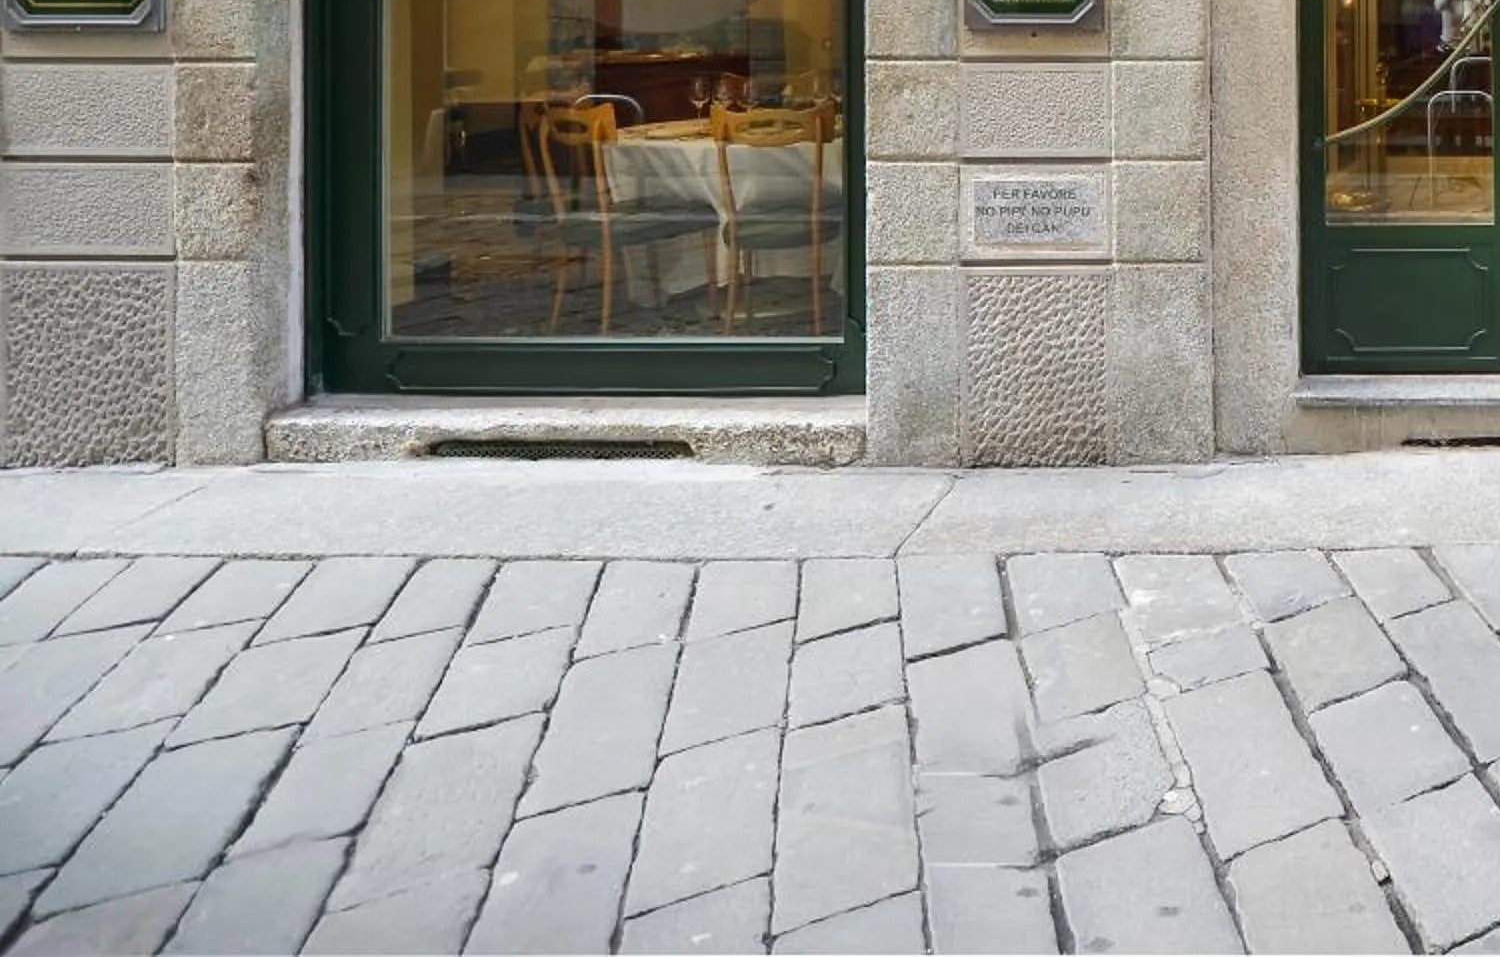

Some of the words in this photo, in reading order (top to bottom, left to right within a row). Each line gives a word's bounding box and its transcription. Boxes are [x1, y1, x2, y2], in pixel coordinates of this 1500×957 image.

[993, 188, 1020, 200] PER
[1023, 188, 1077, 200] FAVORE
[974, 205, 996, 217] NO
[1031, 205, 1052, 217] NO
[1007, 222, 1029, 234] DEI
